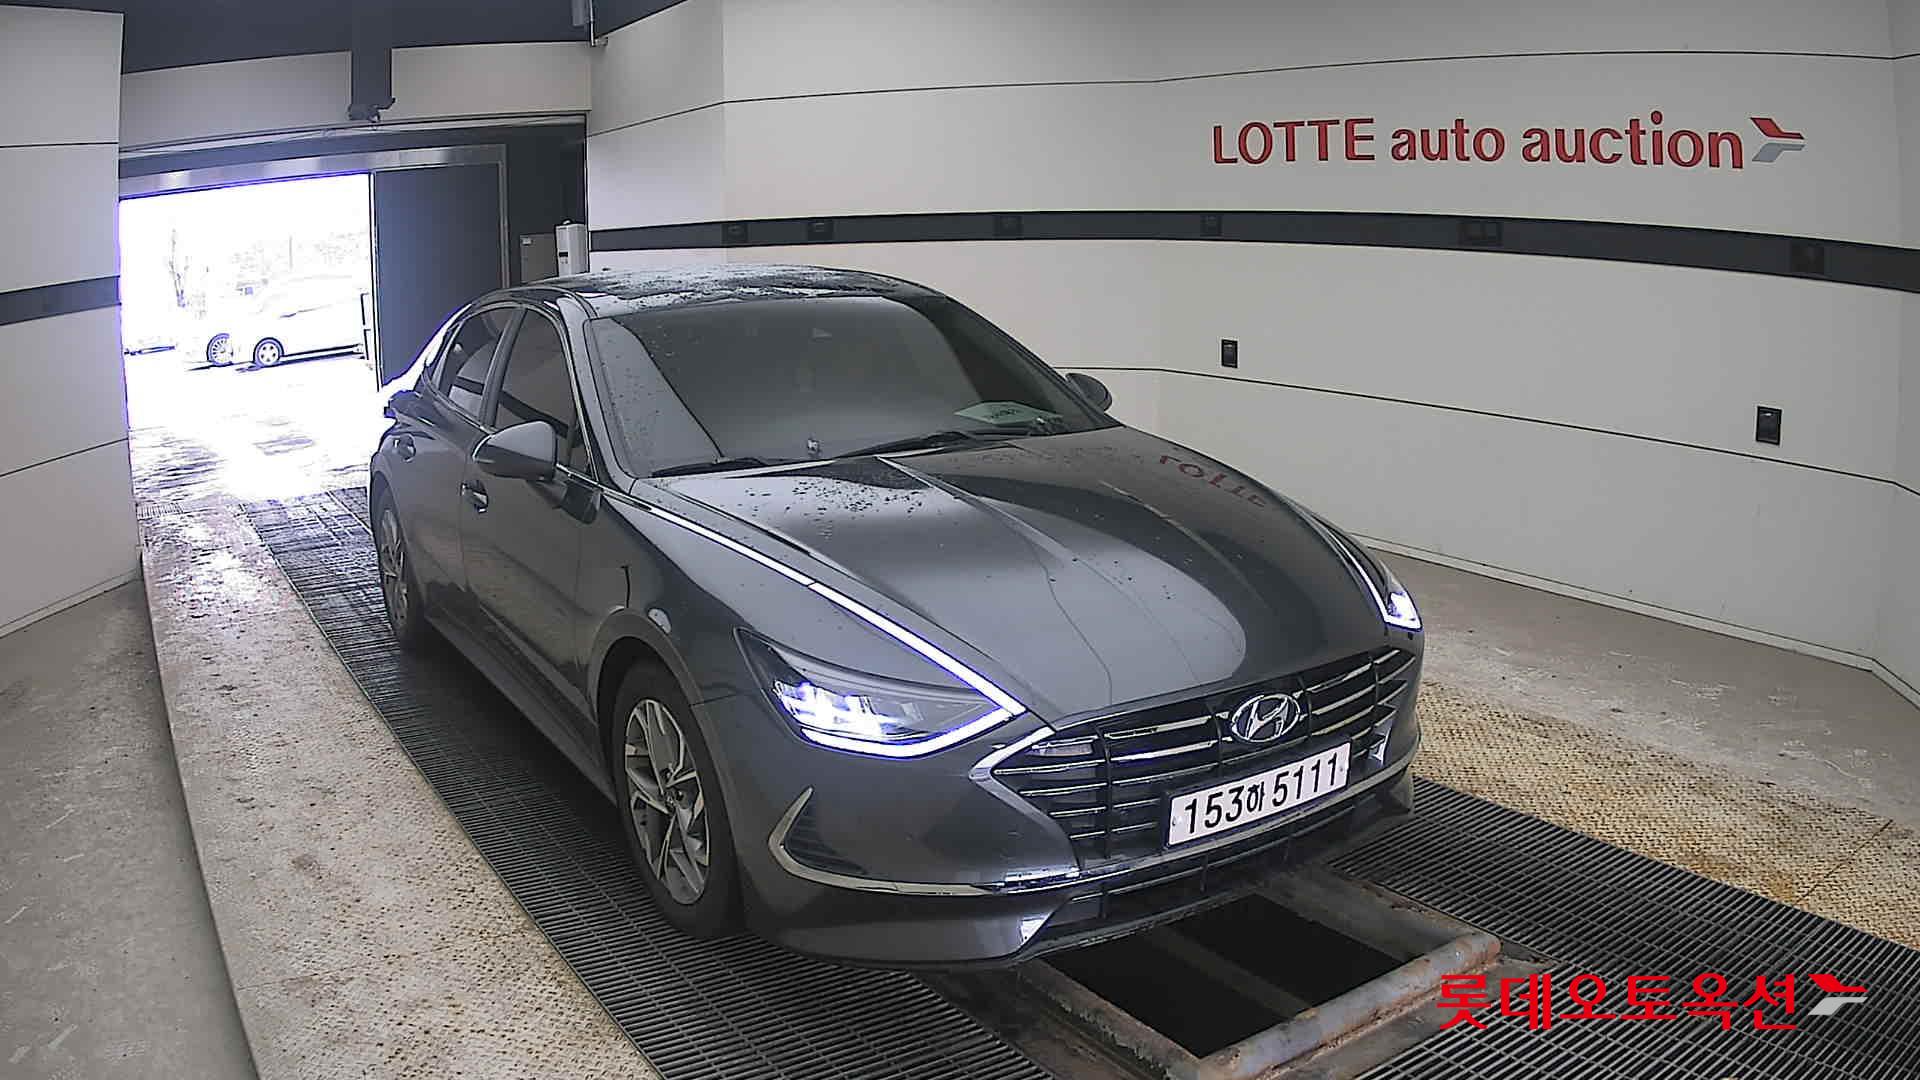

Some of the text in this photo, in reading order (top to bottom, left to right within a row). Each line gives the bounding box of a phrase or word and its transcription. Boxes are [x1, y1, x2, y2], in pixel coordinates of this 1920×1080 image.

[1213, 110, 1745, 169] LOTTE auto auction
[1271, 752, 1337, 808] 5111
